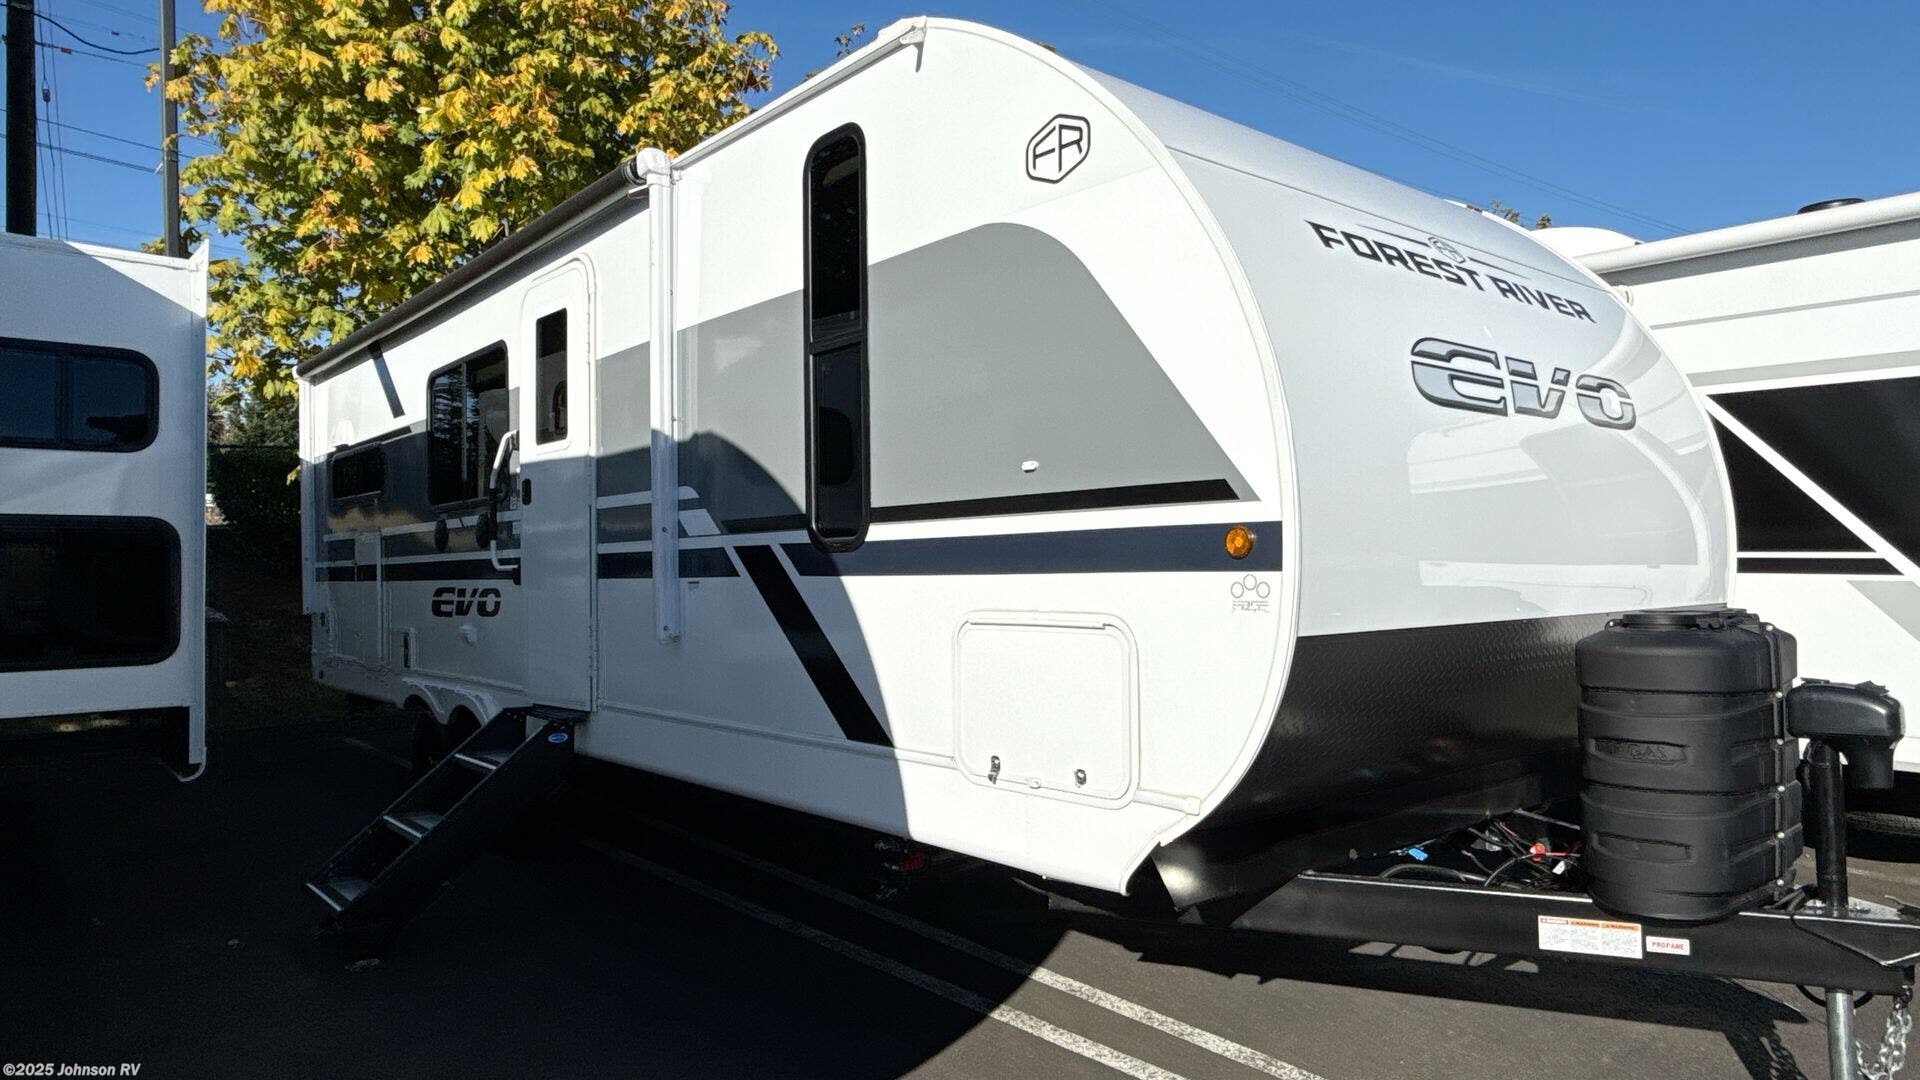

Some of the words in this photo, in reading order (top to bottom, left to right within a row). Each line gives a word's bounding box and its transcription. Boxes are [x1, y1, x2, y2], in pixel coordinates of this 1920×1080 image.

[1304, 220, 1486, 291] FOREST
[1486, 273, 1597, 324] RIVER
[1410, 336, 1637, 431] EVO
[431, 586, 502, 618] EVO
[1651, 941, 1685, 951] PROPANE
